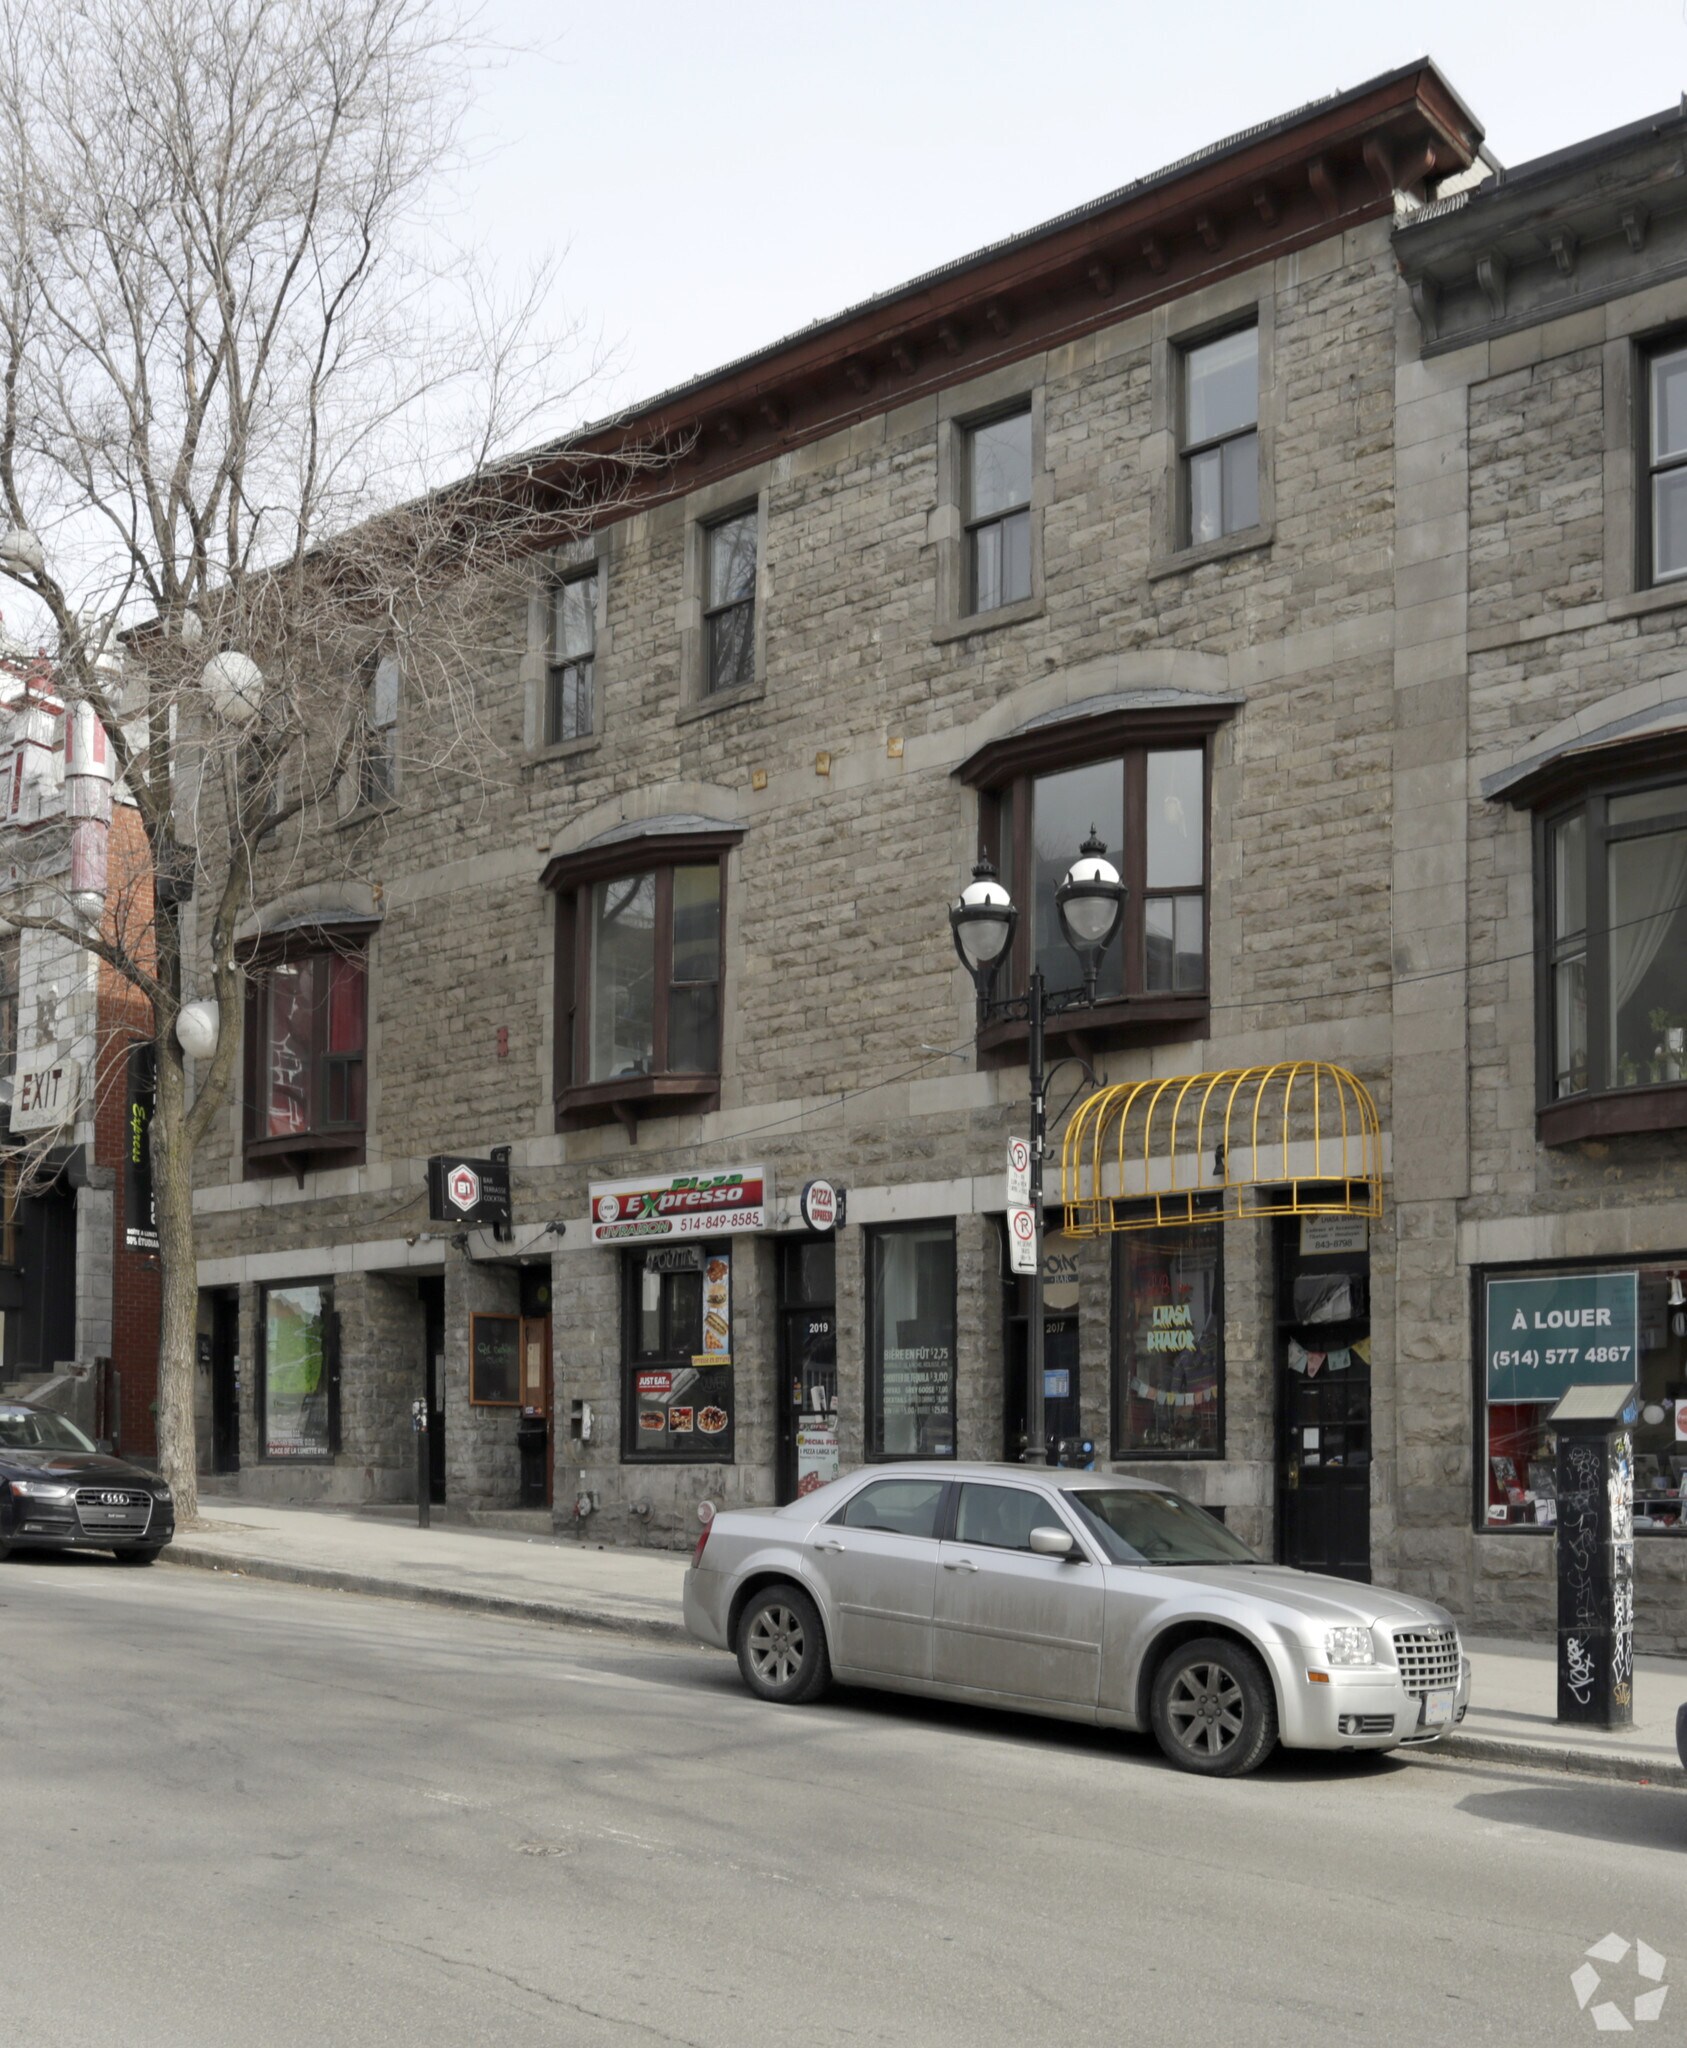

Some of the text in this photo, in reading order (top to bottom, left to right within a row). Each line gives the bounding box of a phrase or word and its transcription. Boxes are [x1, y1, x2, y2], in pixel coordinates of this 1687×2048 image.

[21, 1069, 63, 1112] EXIT
[483, 1176, 493, 1184] BAR
[483, 1185, 506, 1194] TERRASSE
[810, 1187, 832, 1207] PIZZA
[680, 1211, 759, 1232] 514-849-8585
[811, 1209, 833, 1223] EXPRESSO
[600, 1219, 669, 1239] LIVRAISON
[1315, 1239, 1353, 1249] 843-8798
[1152, 1305, 1193, 1328] LHASA
[1511, 1308, 1612, 1330] À LOUER
[809, 1323, 829, 1333] 2019
[1046, 1322, 1066, 1334] 2017
[1146, 1329, 1197, 1352] BHAKOR
[884, 1347, 905, 1360] BIÈRE
[905, 1349, 915, 1360] EN
[915, 1346, 930, 1359] FÛT
[1492, 1346, 1631, 1370] (514) 577 4867
[639, 1376, 654, 1386] JUST
[269, 1447, 284, 1455] PLACE
[284, 1447, 291, 1455] DE
[291, 1447, 297, 1455] LA
